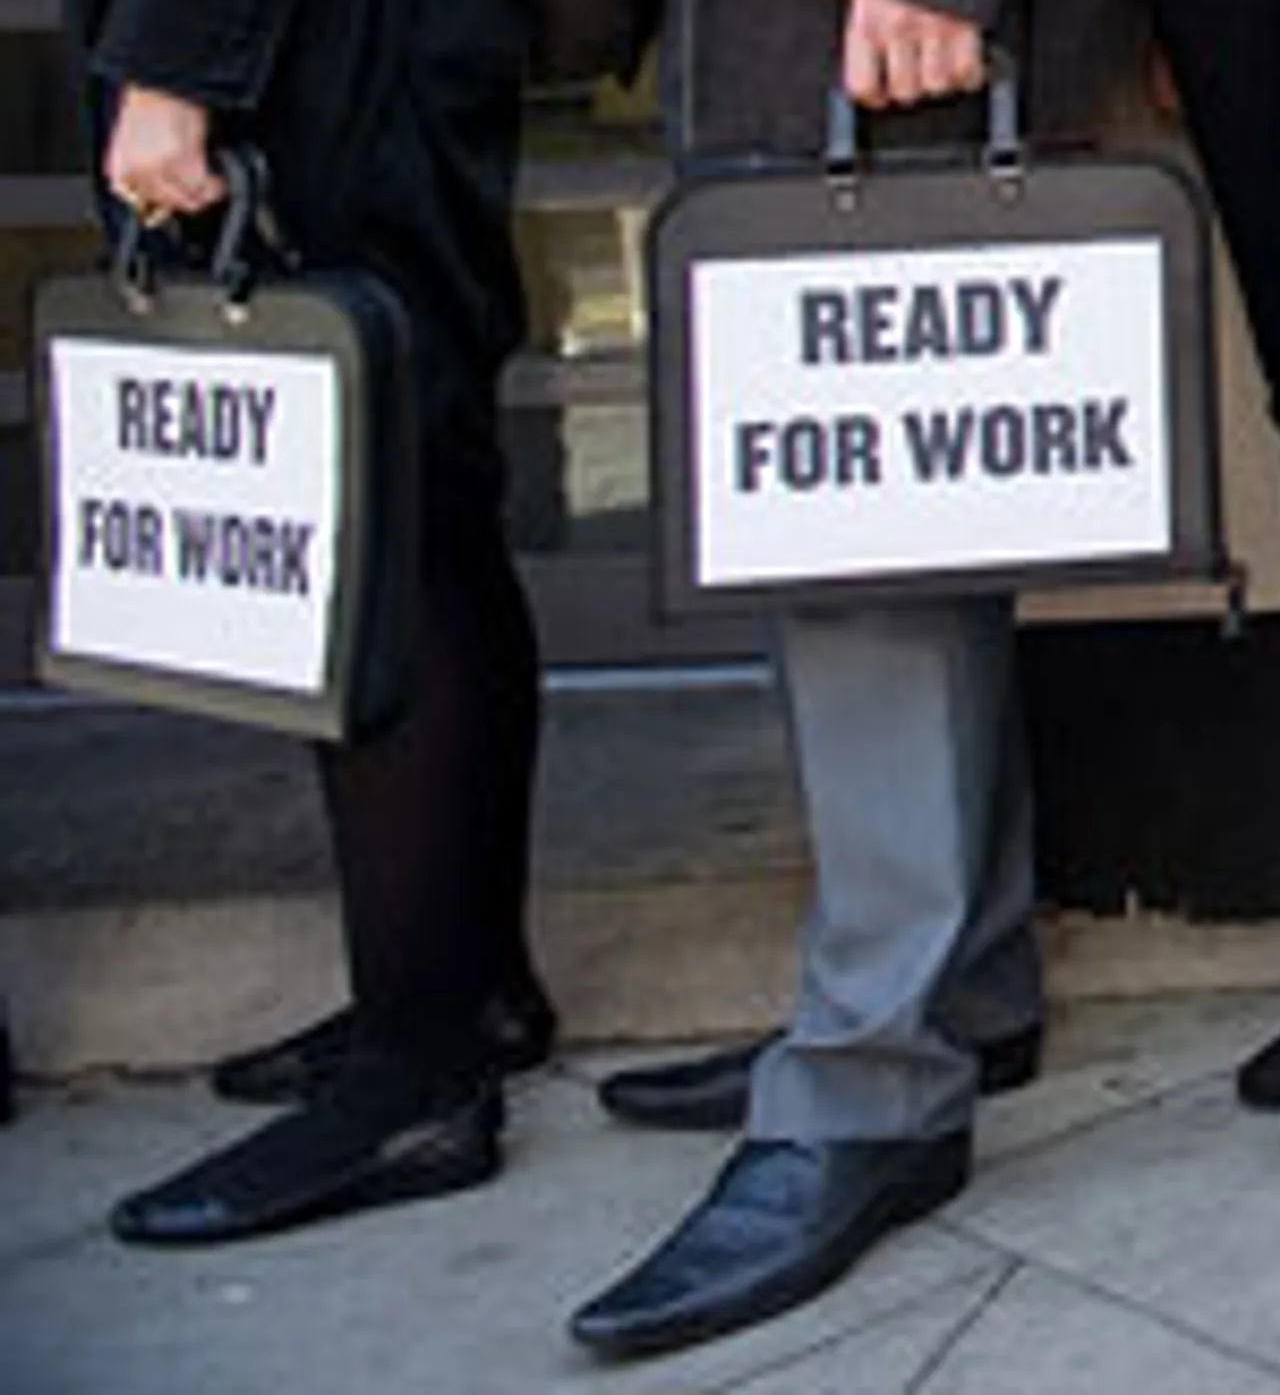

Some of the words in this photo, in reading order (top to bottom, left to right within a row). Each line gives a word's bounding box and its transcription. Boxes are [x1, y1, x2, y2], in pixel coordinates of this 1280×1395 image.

[798, 277, 1062, 365] READY
[117, 378, 275, 465] READY
[733, 415, 881, 494] FOR
[902, 399, 1133, 482] WORK
[79, 499, 162, 576] FOR
[173, 510, 316, 595] WORK
